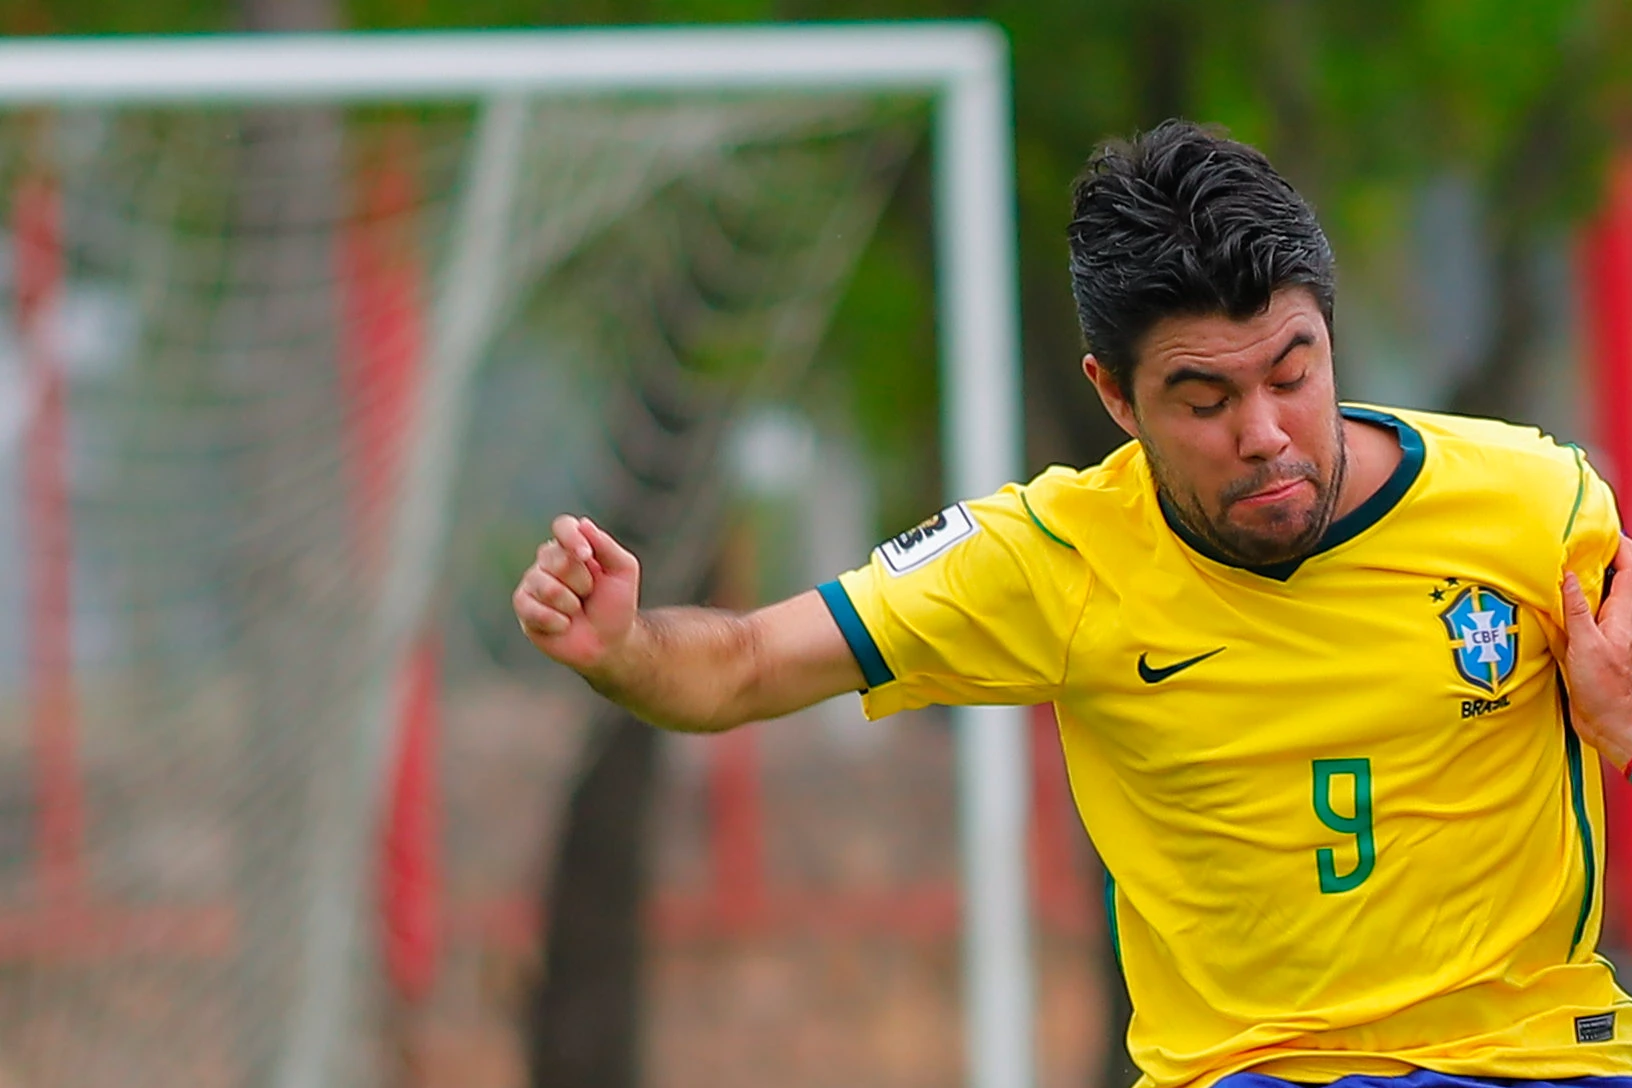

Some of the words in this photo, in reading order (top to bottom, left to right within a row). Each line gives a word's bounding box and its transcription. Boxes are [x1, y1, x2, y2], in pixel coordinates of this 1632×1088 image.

[1472, 629, 1499, 644] CBF
[1461, 696, 1511, 719] BRASIL
[1312, 758, 1376, 894] 9
